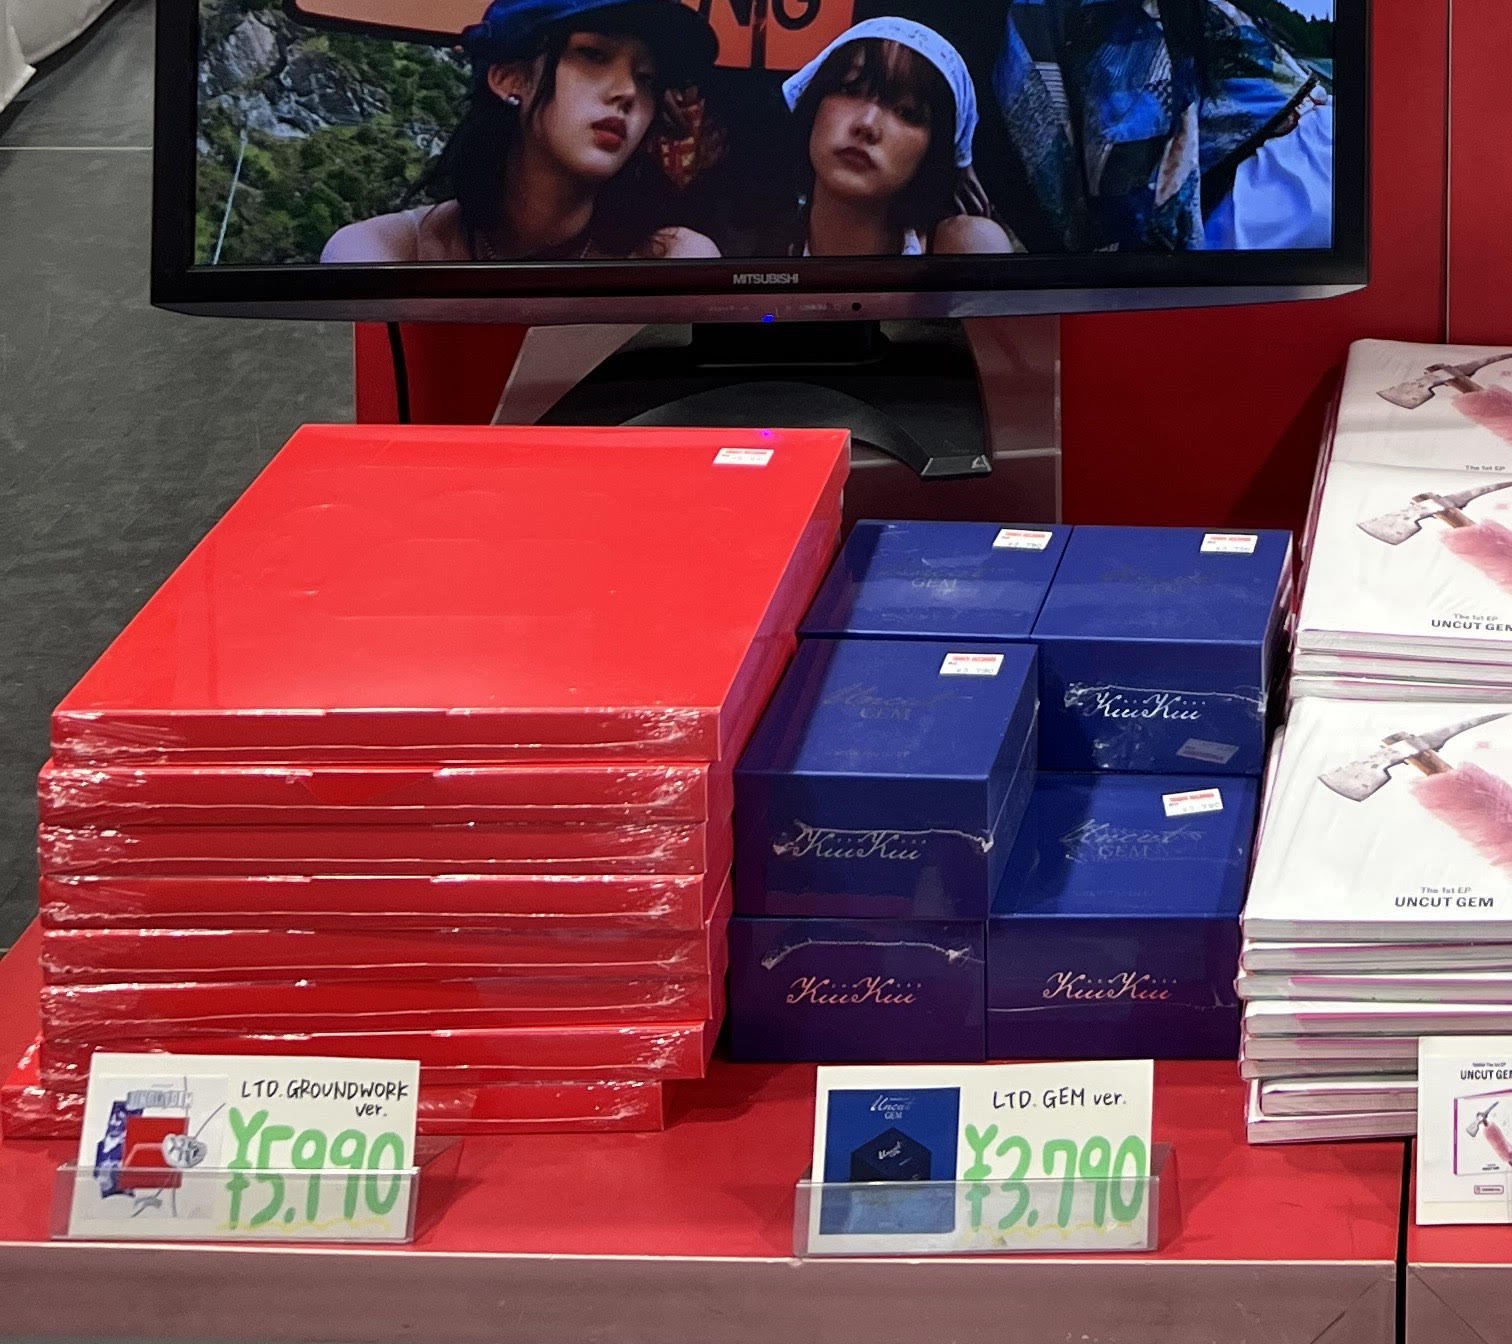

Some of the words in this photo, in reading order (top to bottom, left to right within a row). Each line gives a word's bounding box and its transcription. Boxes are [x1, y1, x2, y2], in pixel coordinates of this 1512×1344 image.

[733, 273, 799, 285] MITSUBISHI
[1431, 620, 1481, 630] UNCUT
[1395, 897, 1452, 907] UNCUT
[1456, 897, 1494, 907] GEM
[1460, 1070, 1494, 1080] UNCUT
[1043, 1086, 1085, 1108] GEM
[1093, 1091, 1127, 1107] ver.
[355, 1103, 388, 1118] ver.
